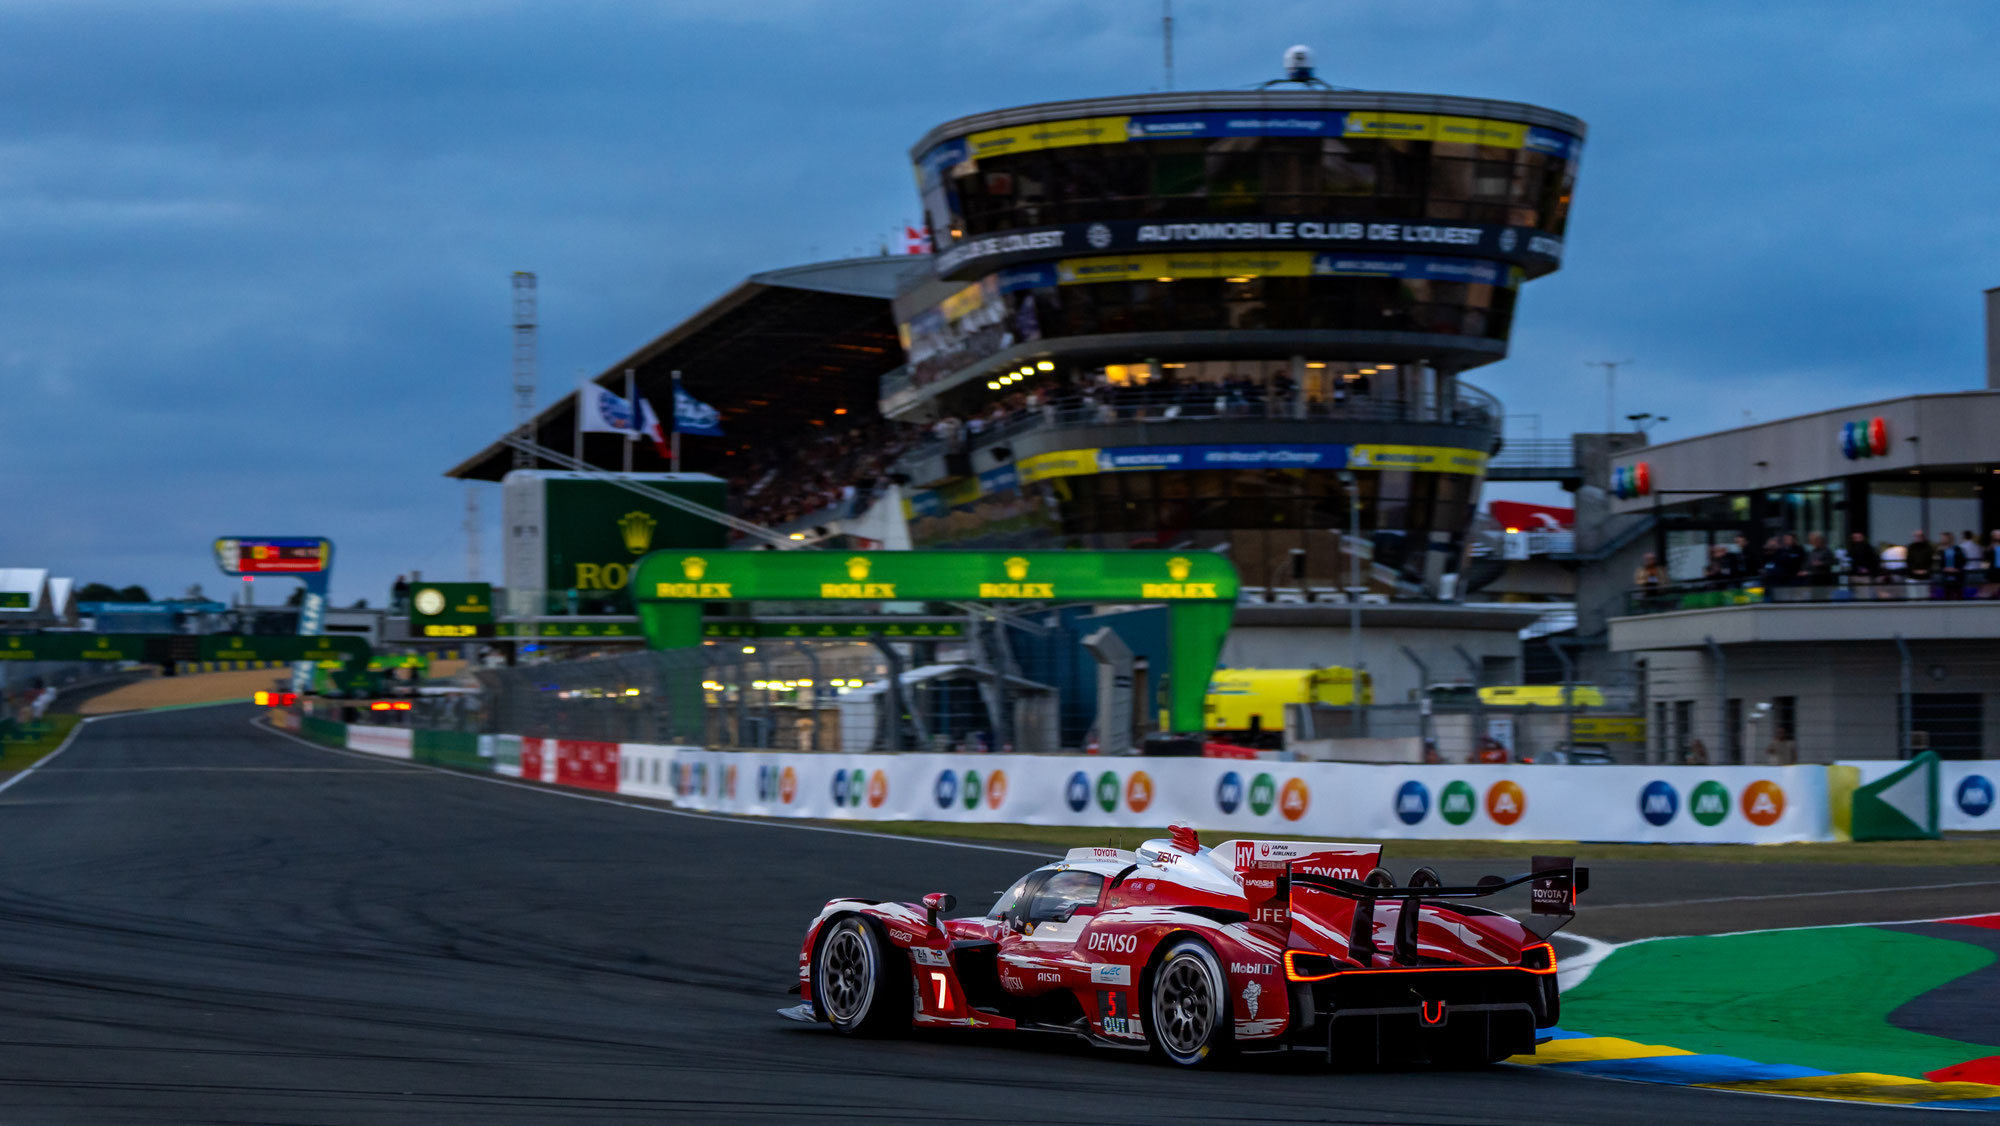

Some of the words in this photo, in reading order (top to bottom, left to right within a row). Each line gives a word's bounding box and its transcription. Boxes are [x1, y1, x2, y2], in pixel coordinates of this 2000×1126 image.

[1137, 222, 1295, 241] AUTOMOBILE
[1297, 222, 1364, 239] CLUB
[1367, 223, 1400, 241] DE
[1402, 225, 1483, 244] L'OUEST
[656, 582, 733, 599] ROLEX
[820, 582, 897, 599] ROLEX
[979, 582, 1056, 599] ROLEX
[1141, 582, 1218, 599] ROLEX
[1093, 848, 1118, 858] TOYOTA
[1156, 851, 1182, 864] ZENT
[1236, 846, 1253, 867] HY
[1532, 889, 1562, 899] TOYOTA
[1562, 890, 1569, 903] 7
[1251, 907, 1284, 923] JFE
[1087, 932, 1138, 954] DENSO
[1230, 962, 1261, 974] Mobil
[1037, 972, 1061, 983] AISIN
[930, 972, 947, 1009] 7
[1107, 991, 1117, 1017] 5
[1103, 1016, 1126, 1033] OUT
